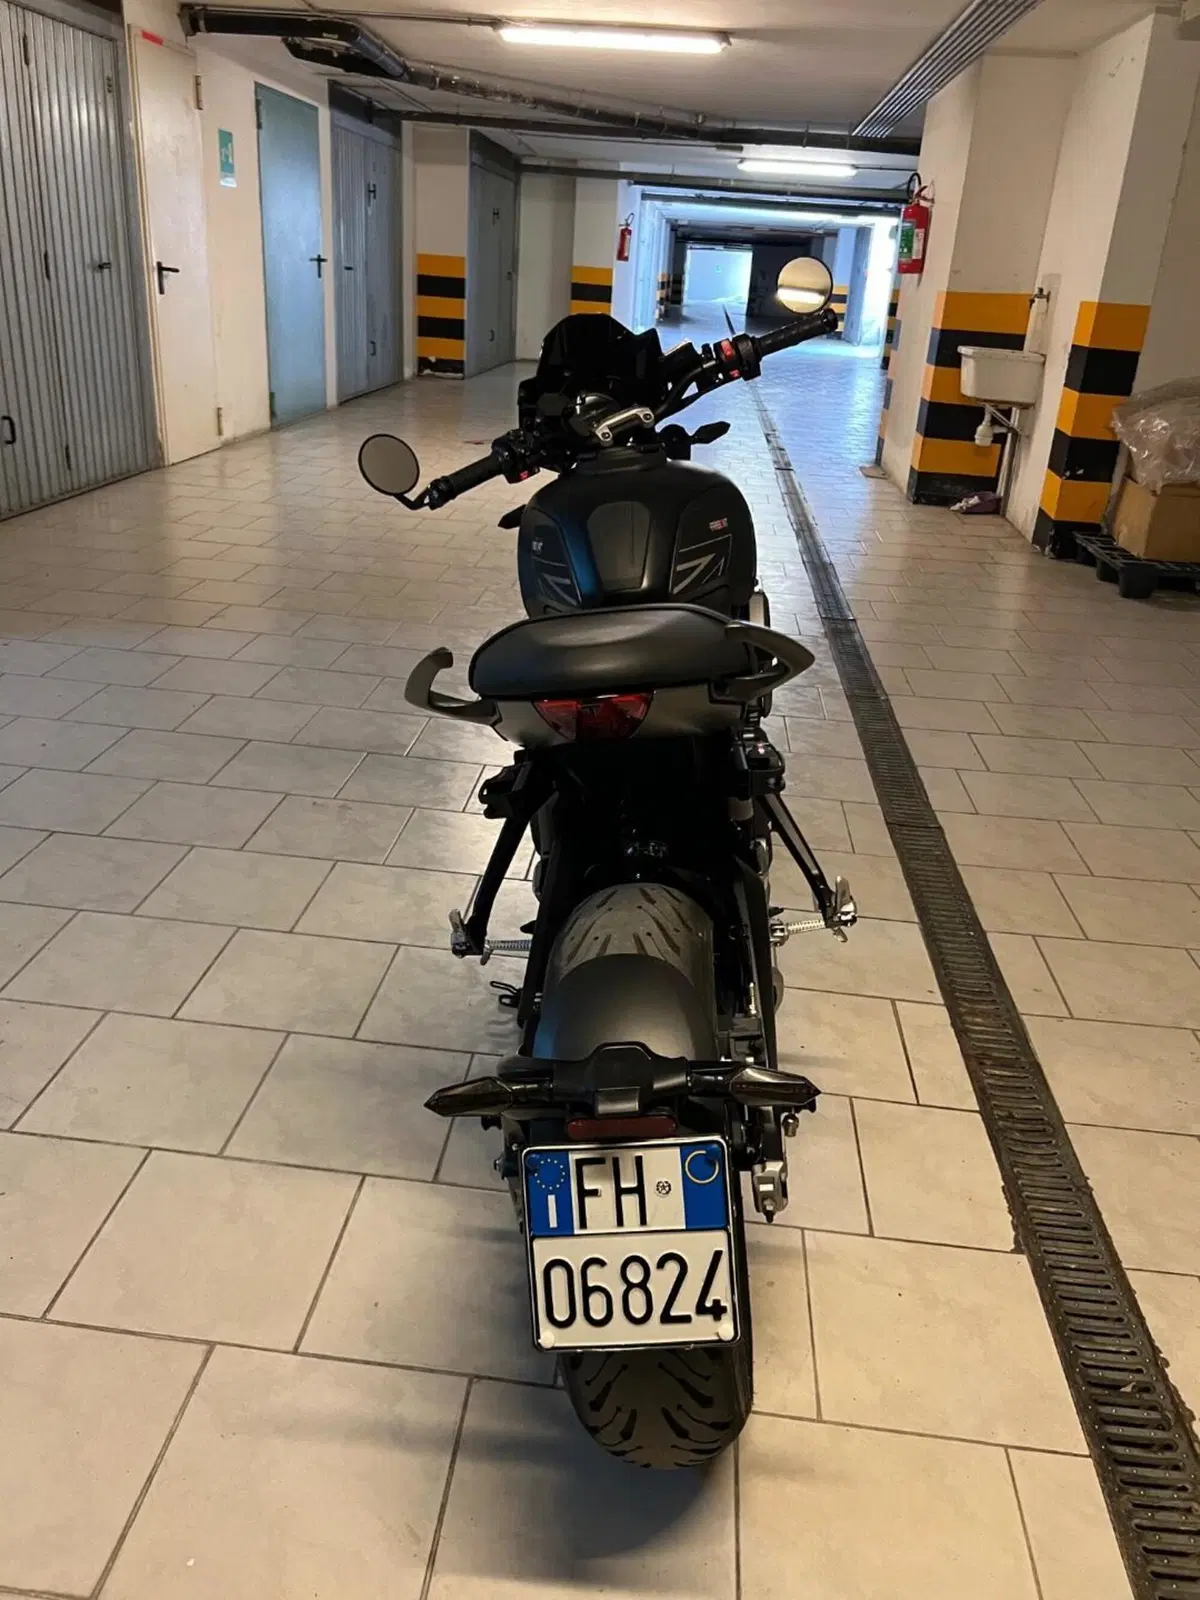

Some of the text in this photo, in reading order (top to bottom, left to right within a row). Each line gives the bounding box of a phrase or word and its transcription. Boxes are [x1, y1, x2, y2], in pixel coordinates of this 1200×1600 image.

[547, 1194, 558, 1229] I
[575, 1155, 648, 1229] FH
[543, 1250, 728, 1329] 06824
